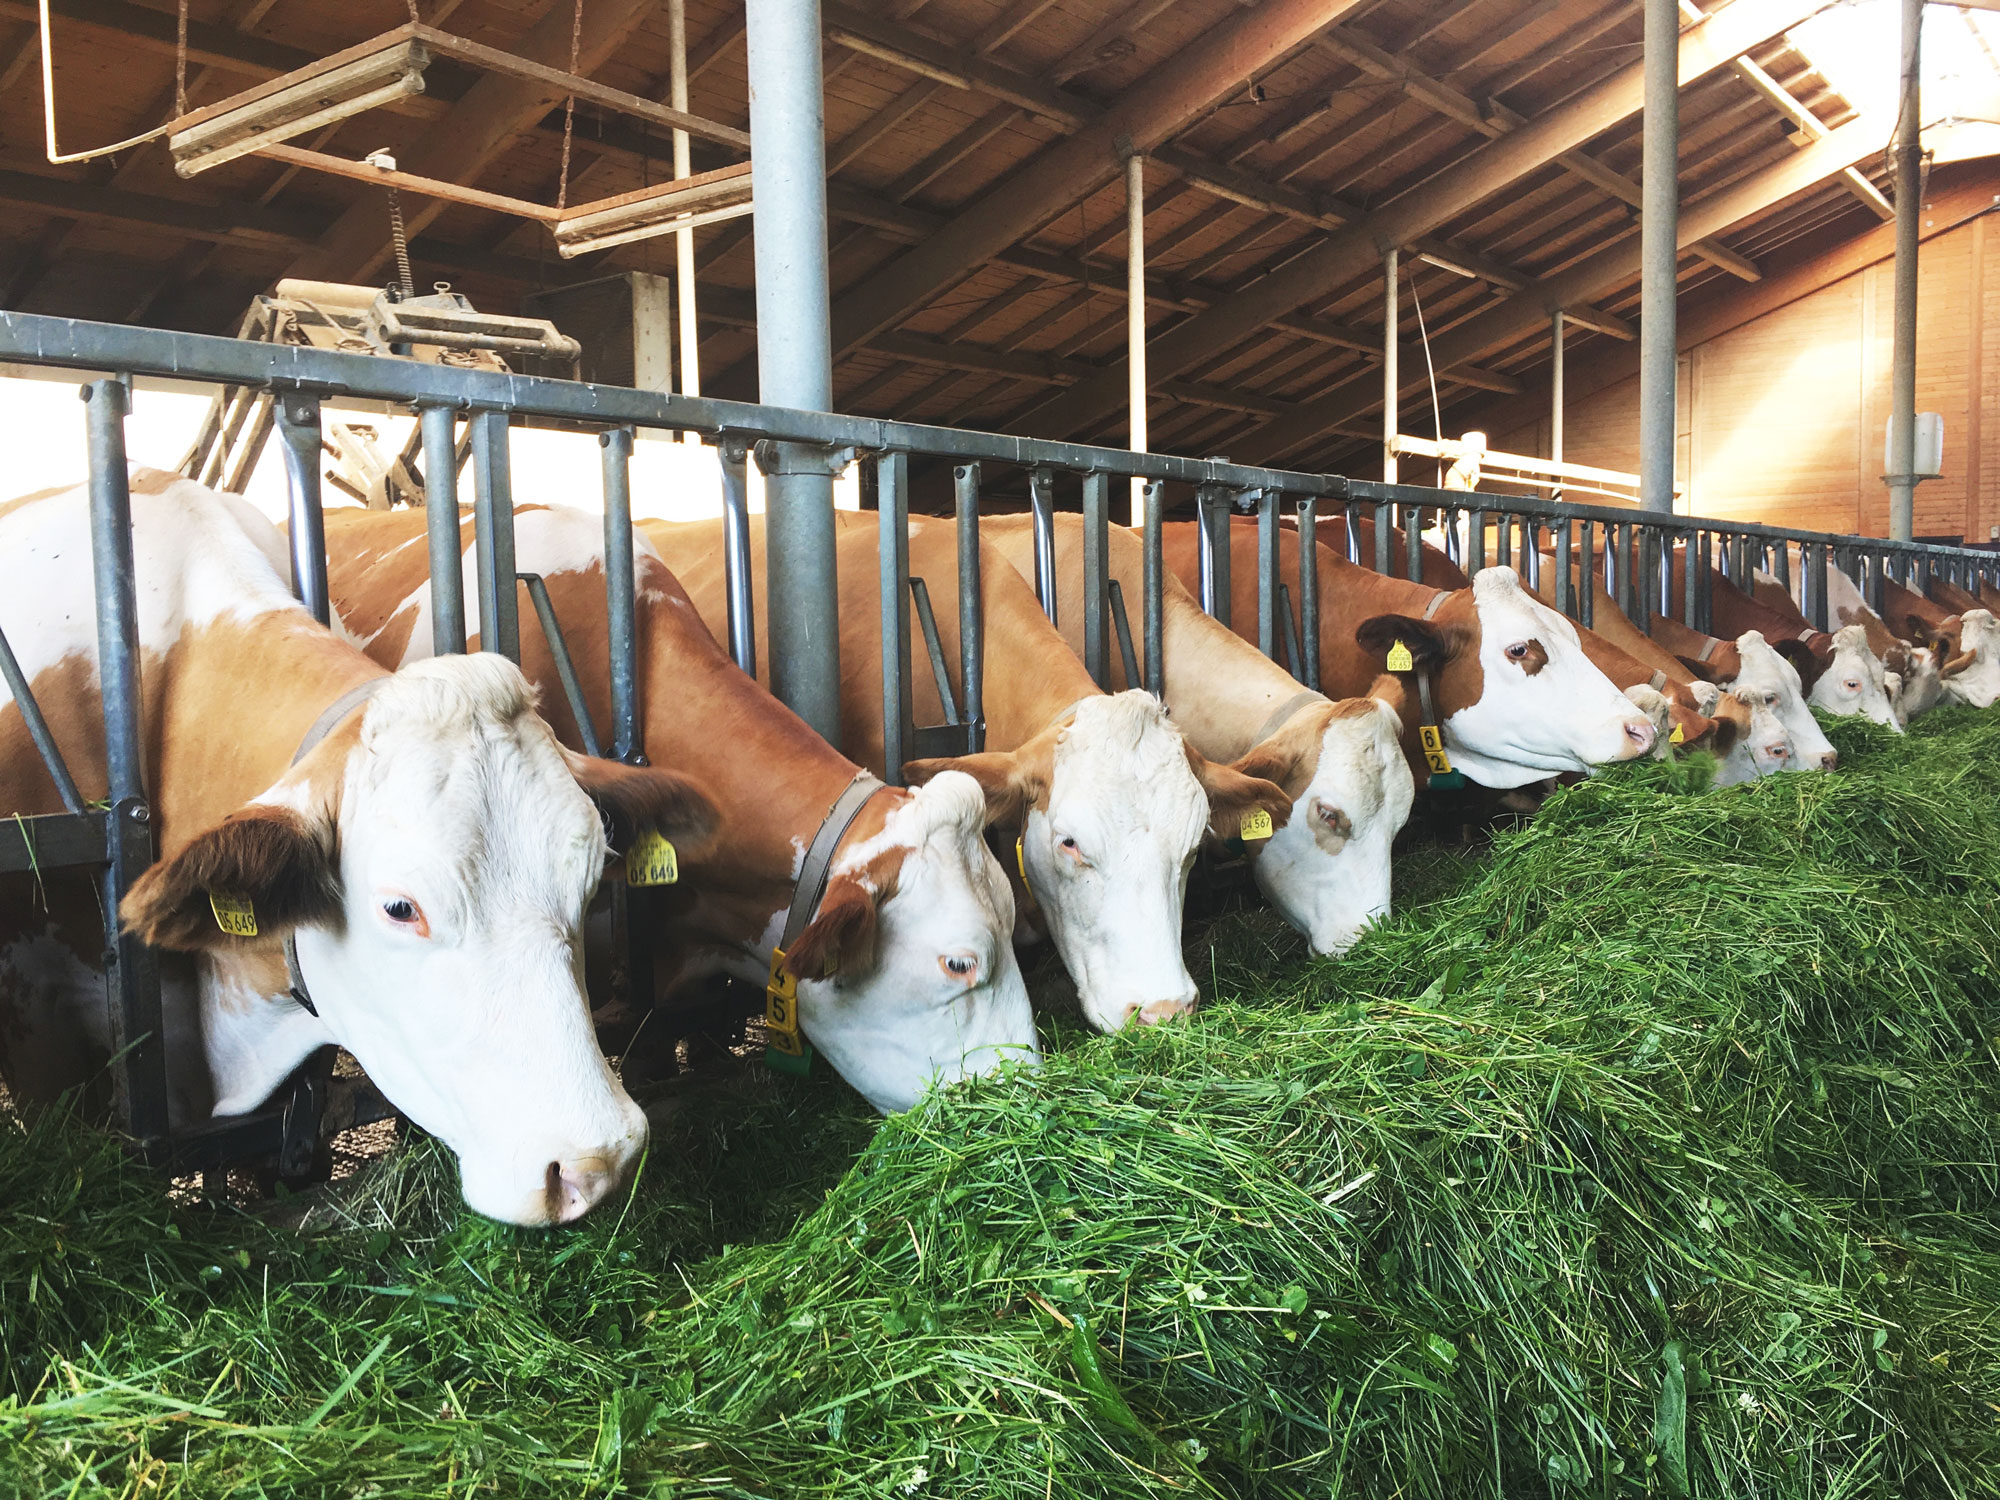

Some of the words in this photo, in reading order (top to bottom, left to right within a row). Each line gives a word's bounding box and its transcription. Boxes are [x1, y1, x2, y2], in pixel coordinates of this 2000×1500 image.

[1254, 817, 1271, 829] 567
[217, 911, 234, 931] 05
[235, 914, 255, 933] 649
[772, 995, 786, 1023] 5
